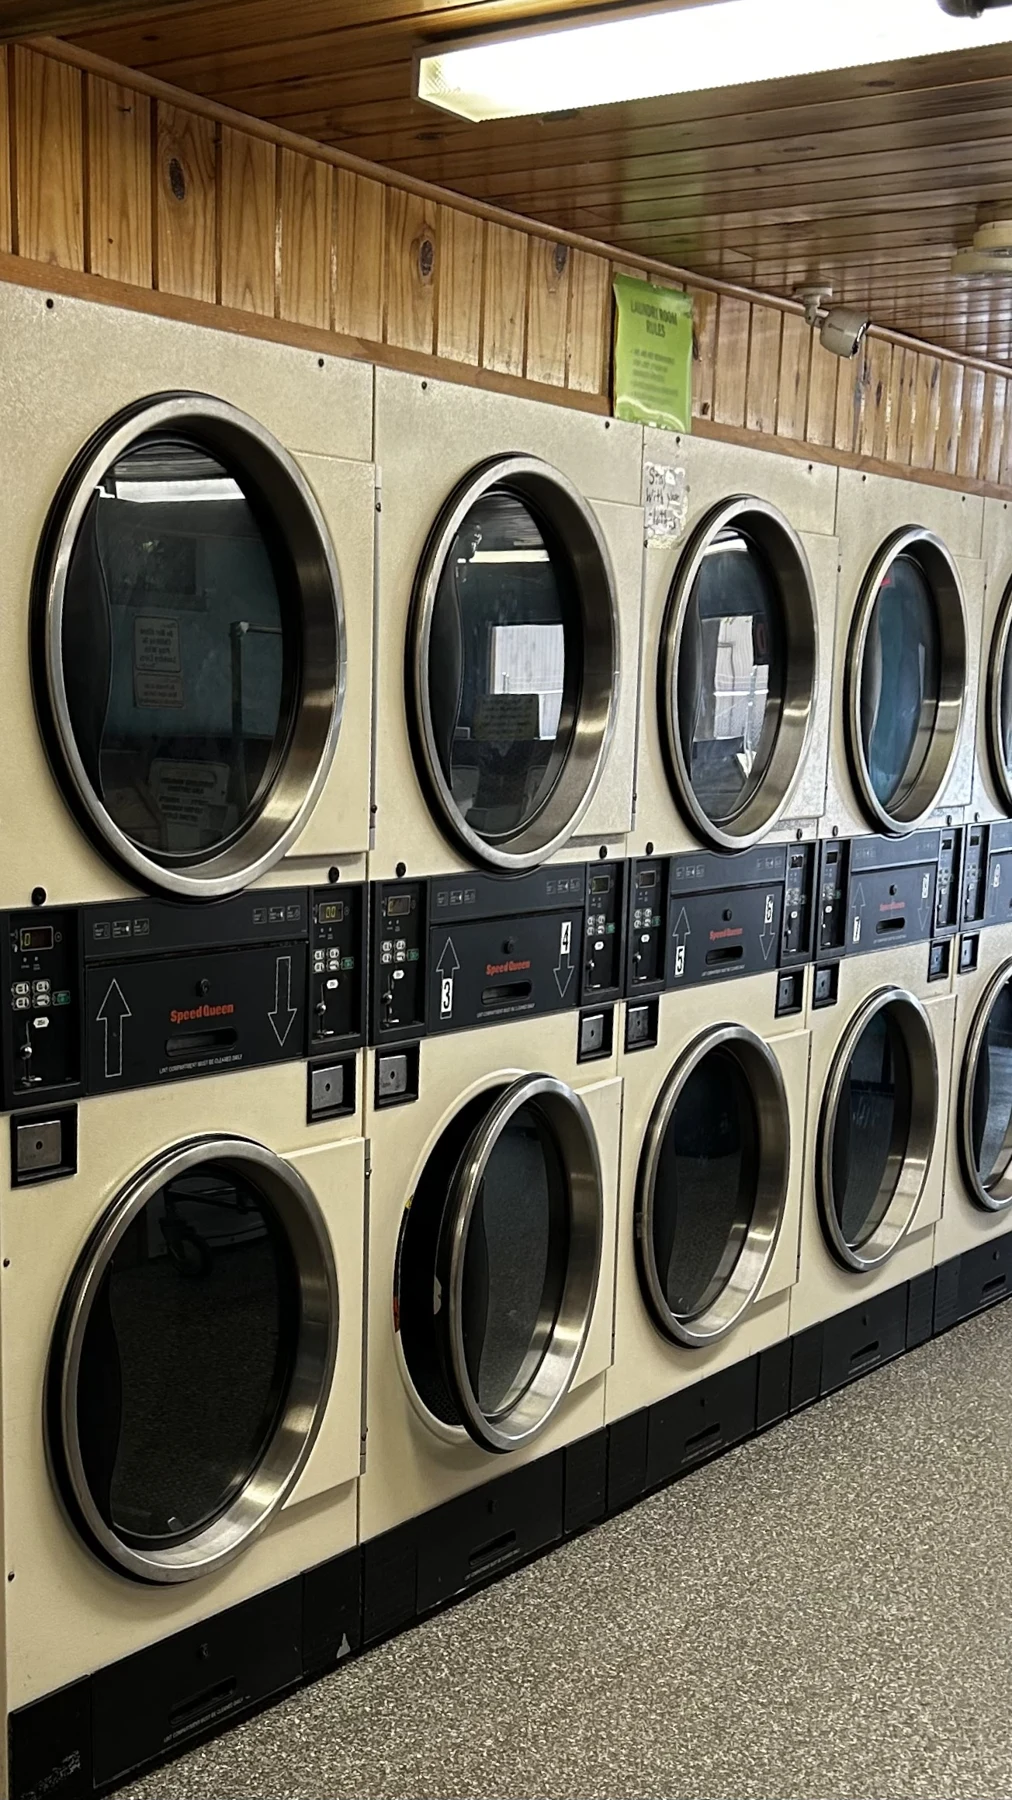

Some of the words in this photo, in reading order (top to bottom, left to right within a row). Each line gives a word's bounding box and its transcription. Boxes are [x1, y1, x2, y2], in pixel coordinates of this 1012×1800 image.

[631, 300, 659, 320] LAUNDRY
[660, 308, 677, 326] ROOM
[646, 319, 666, 338] RULES
[562, 924, 569, 952] 4
[676, 948, 684, 973] 5
[443, 981, 451, 1009] 3
